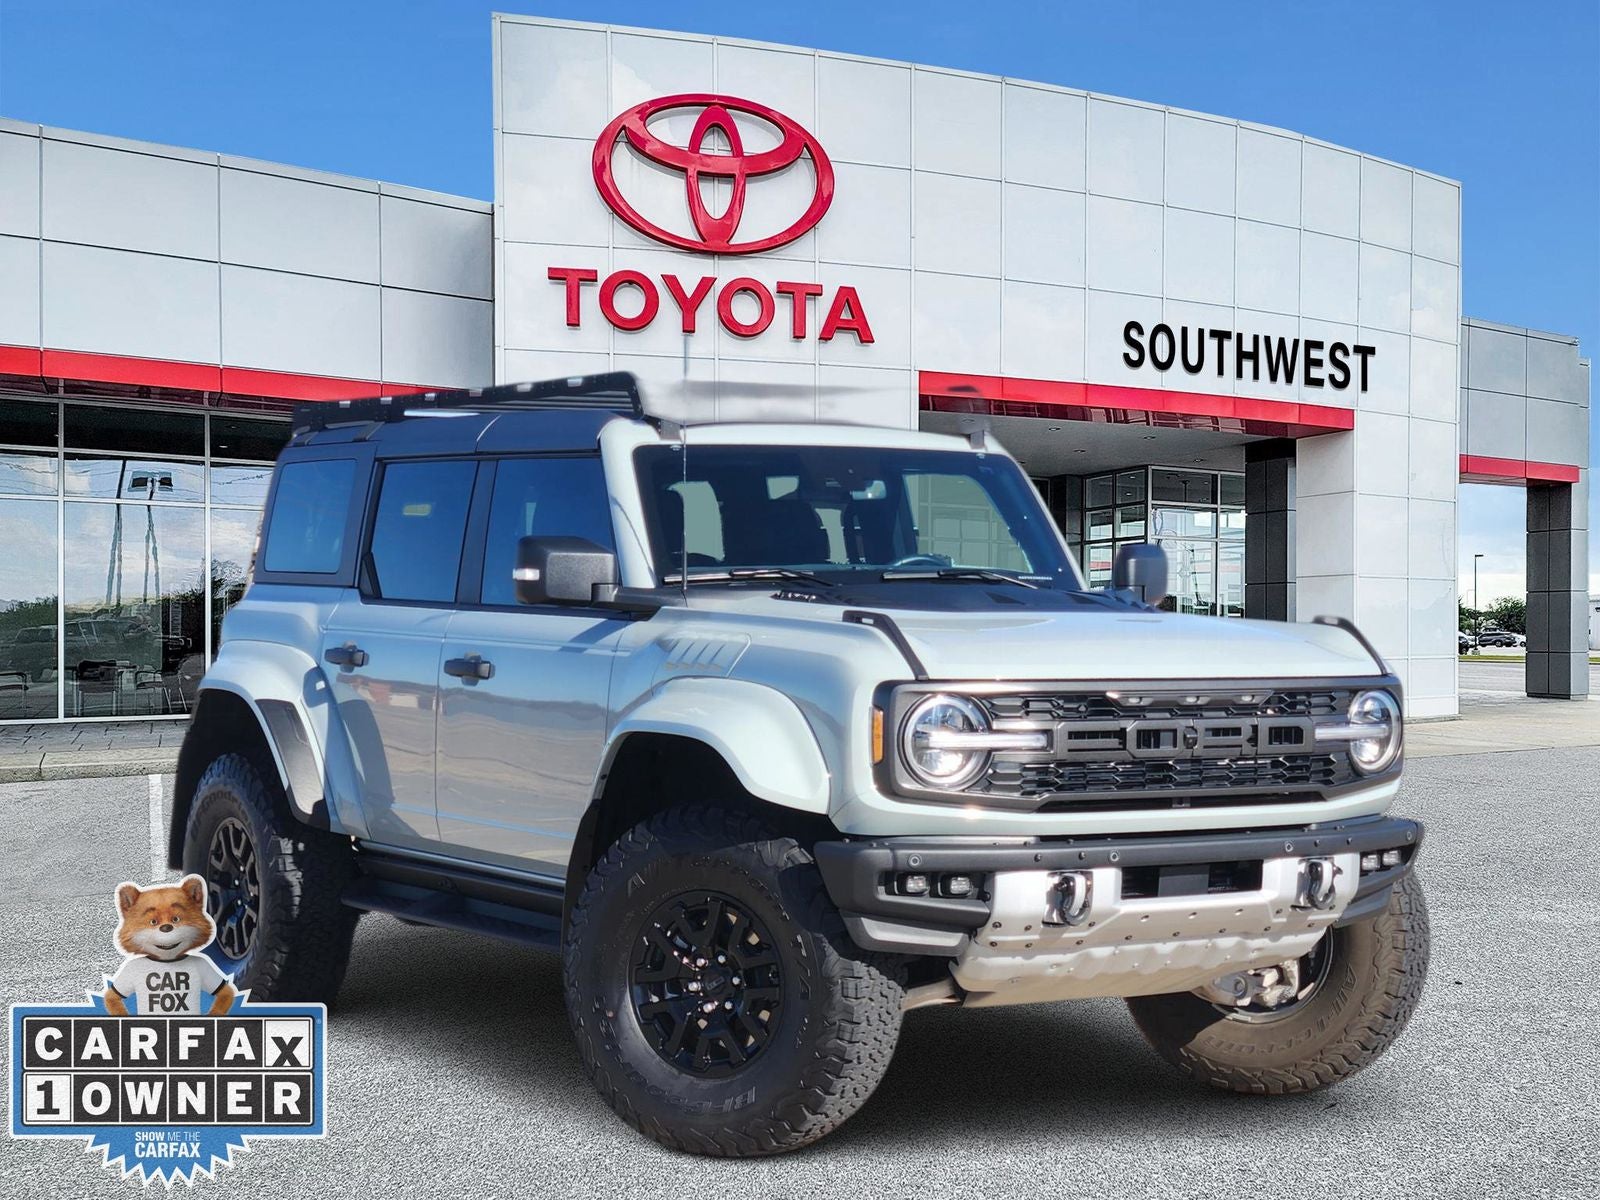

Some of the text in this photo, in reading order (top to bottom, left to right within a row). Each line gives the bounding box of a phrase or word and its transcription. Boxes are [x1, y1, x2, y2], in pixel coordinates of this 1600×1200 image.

[547, 266, 876, 344] TOYOTA
[1122, 320, 1376, 392] SOUTHWEST
[1057, 717, 1315, 761] FORD
